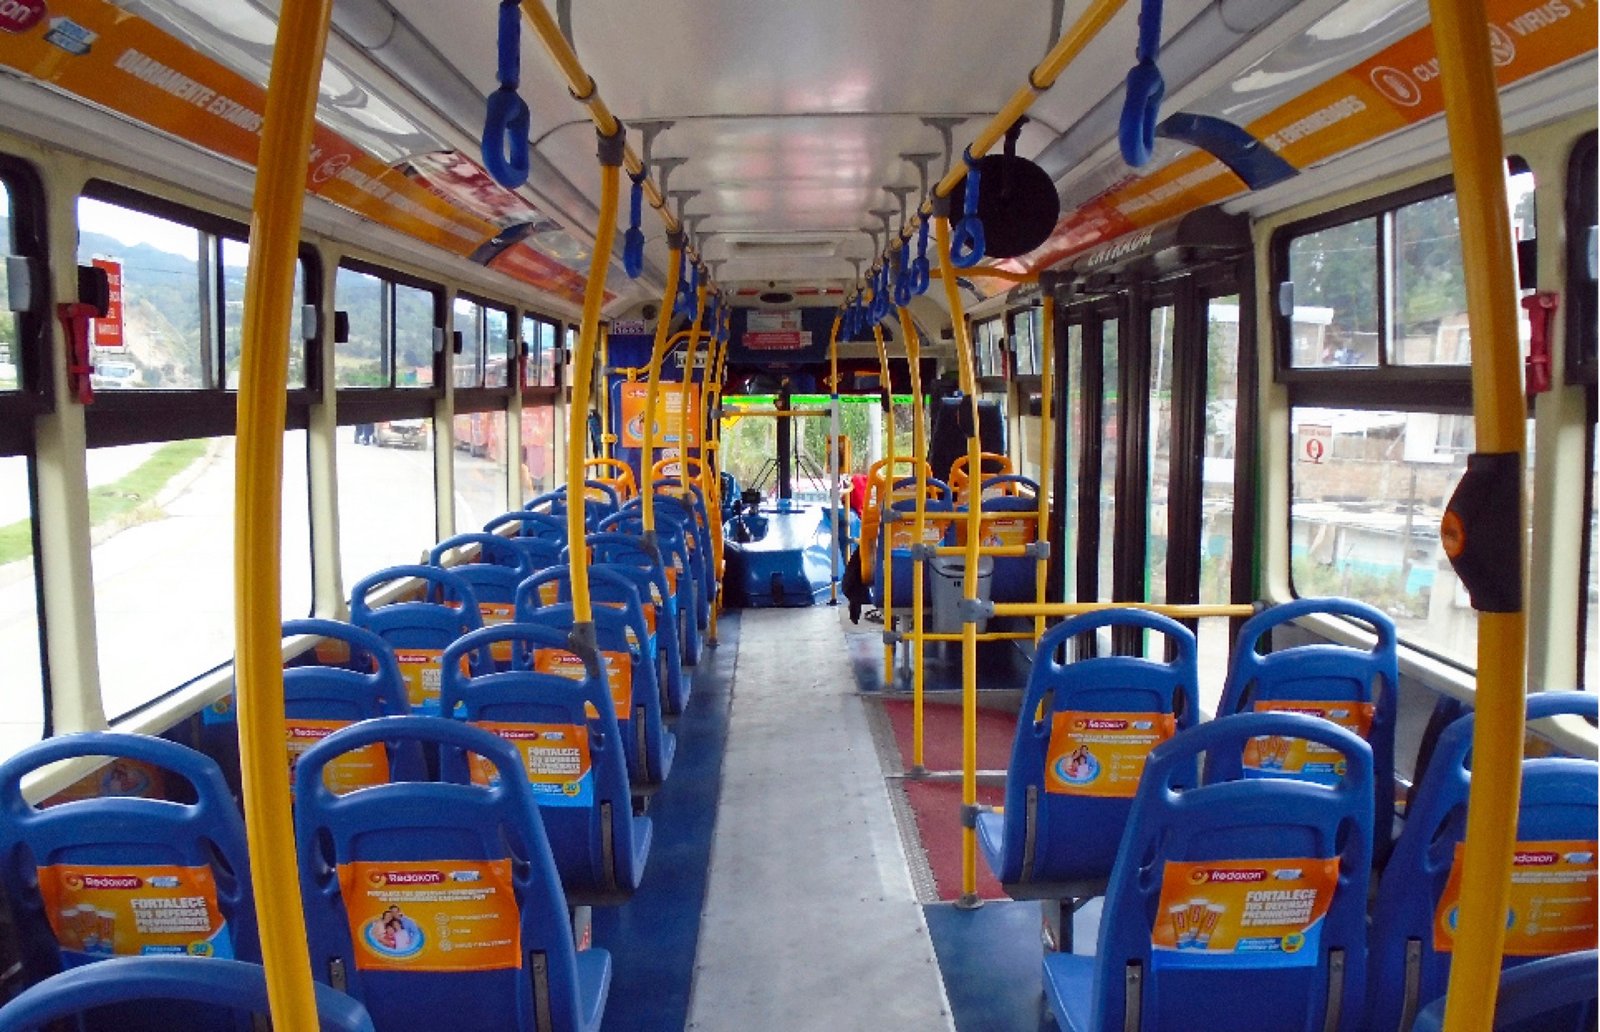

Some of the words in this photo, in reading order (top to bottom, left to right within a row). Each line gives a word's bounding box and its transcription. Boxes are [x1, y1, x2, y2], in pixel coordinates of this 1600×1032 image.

[1507, 2, 1571, 37] VIRUS
[113, 47, 217, 108] DIARIAMENTE
[1306, 438, 1324, 464] Q
[85, 876, 139, 887] Redoxon
[387, 872, 441, 883] Redoxon
[1211, 870, 1263, 880] Redoxon
[1246, 889, 1317, 902] FORTALECE
[130, 896, 207, 909] FORTALECE
